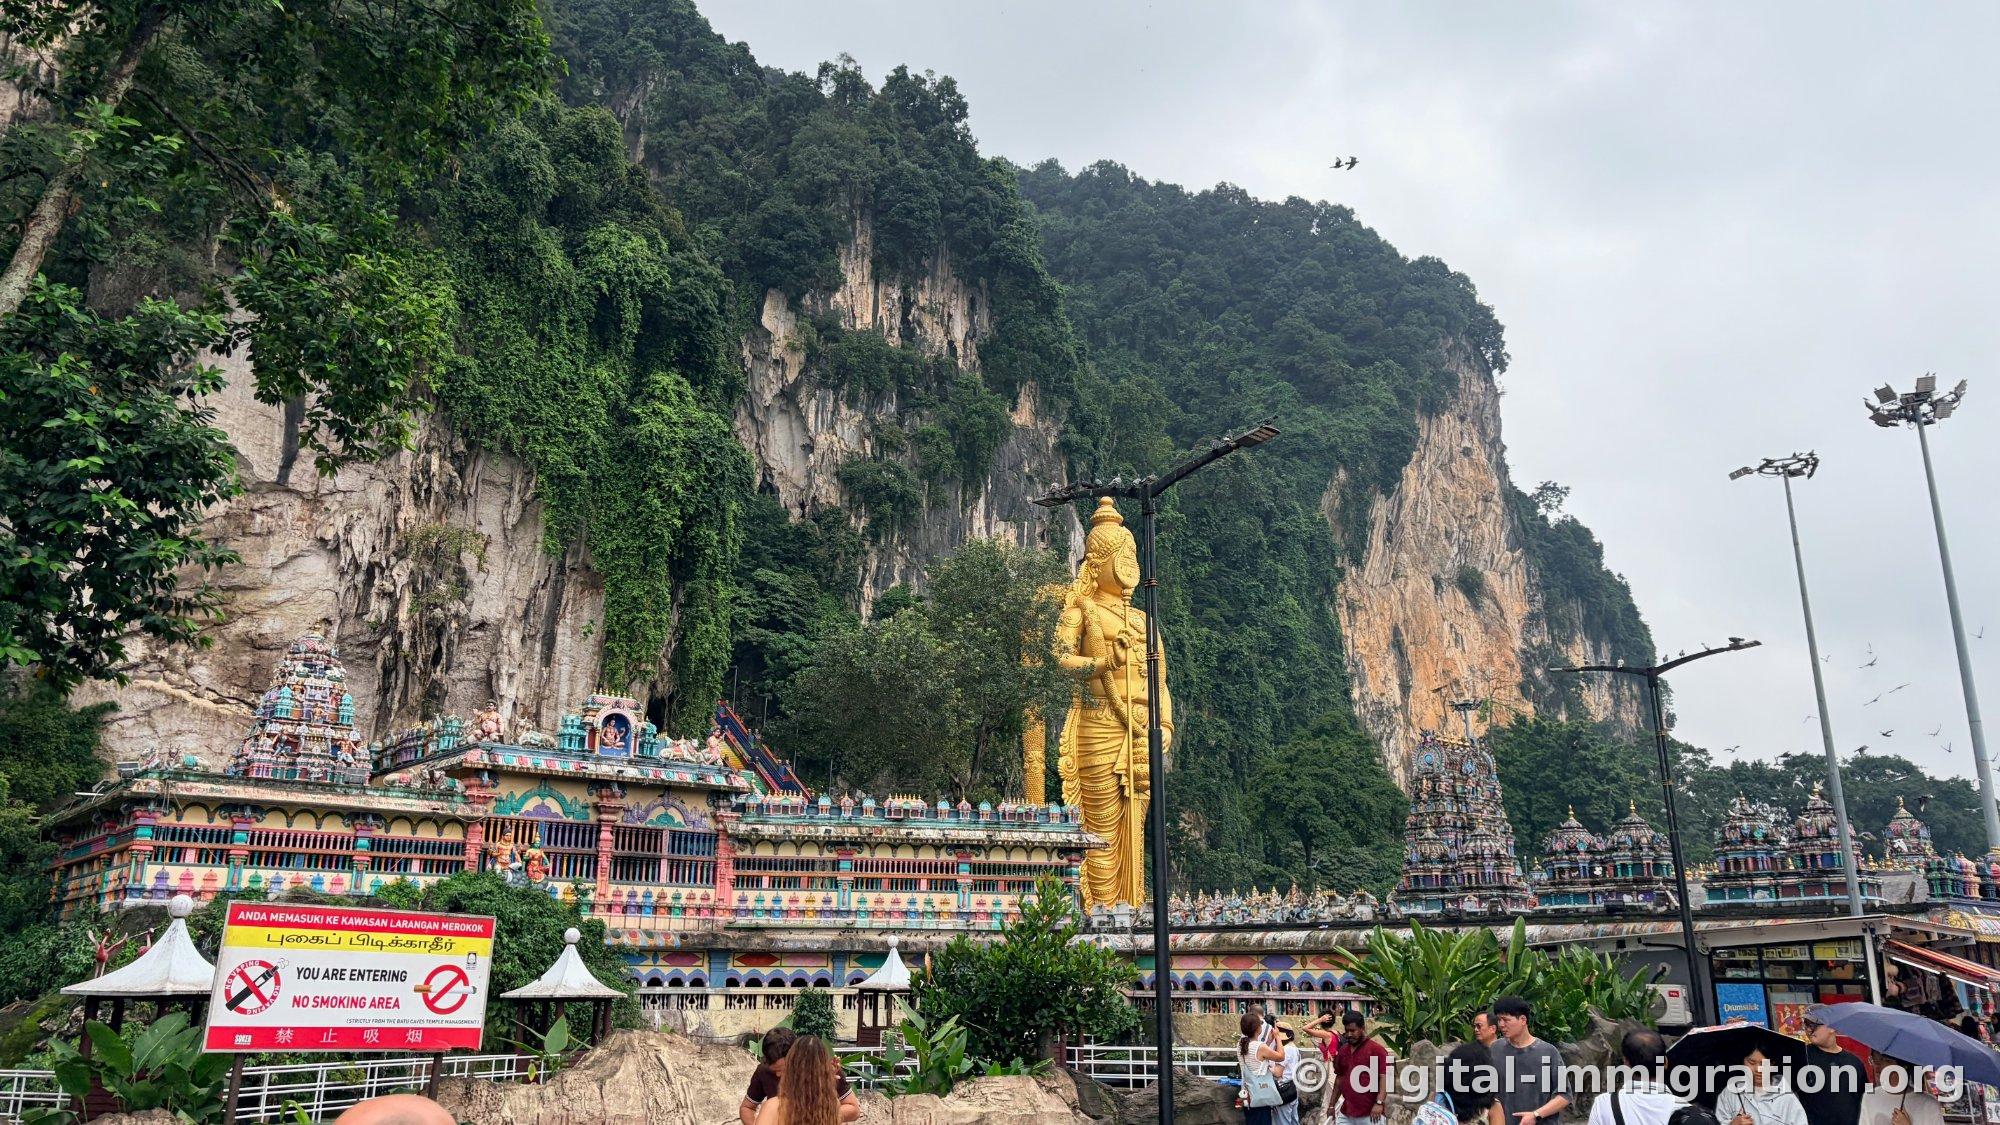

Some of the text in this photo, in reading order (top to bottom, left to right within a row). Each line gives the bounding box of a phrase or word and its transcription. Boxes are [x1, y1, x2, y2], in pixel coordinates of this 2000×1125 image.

[237, 910, 484, 933] ANDA MEMASUKI KE KAWASAN LARANGAN MEROKOK
[266, 932, 456, 953] புகைப் பிடிக்காதீர்
[225, 960, 260, 990] NO VAPING
[296, 966, 408, 983] YOU ARE ENTERING
[291, 994, 401, 1009] NO SMOKING AREA
[275, 1028, 423, 1045] 禁止吸烟
